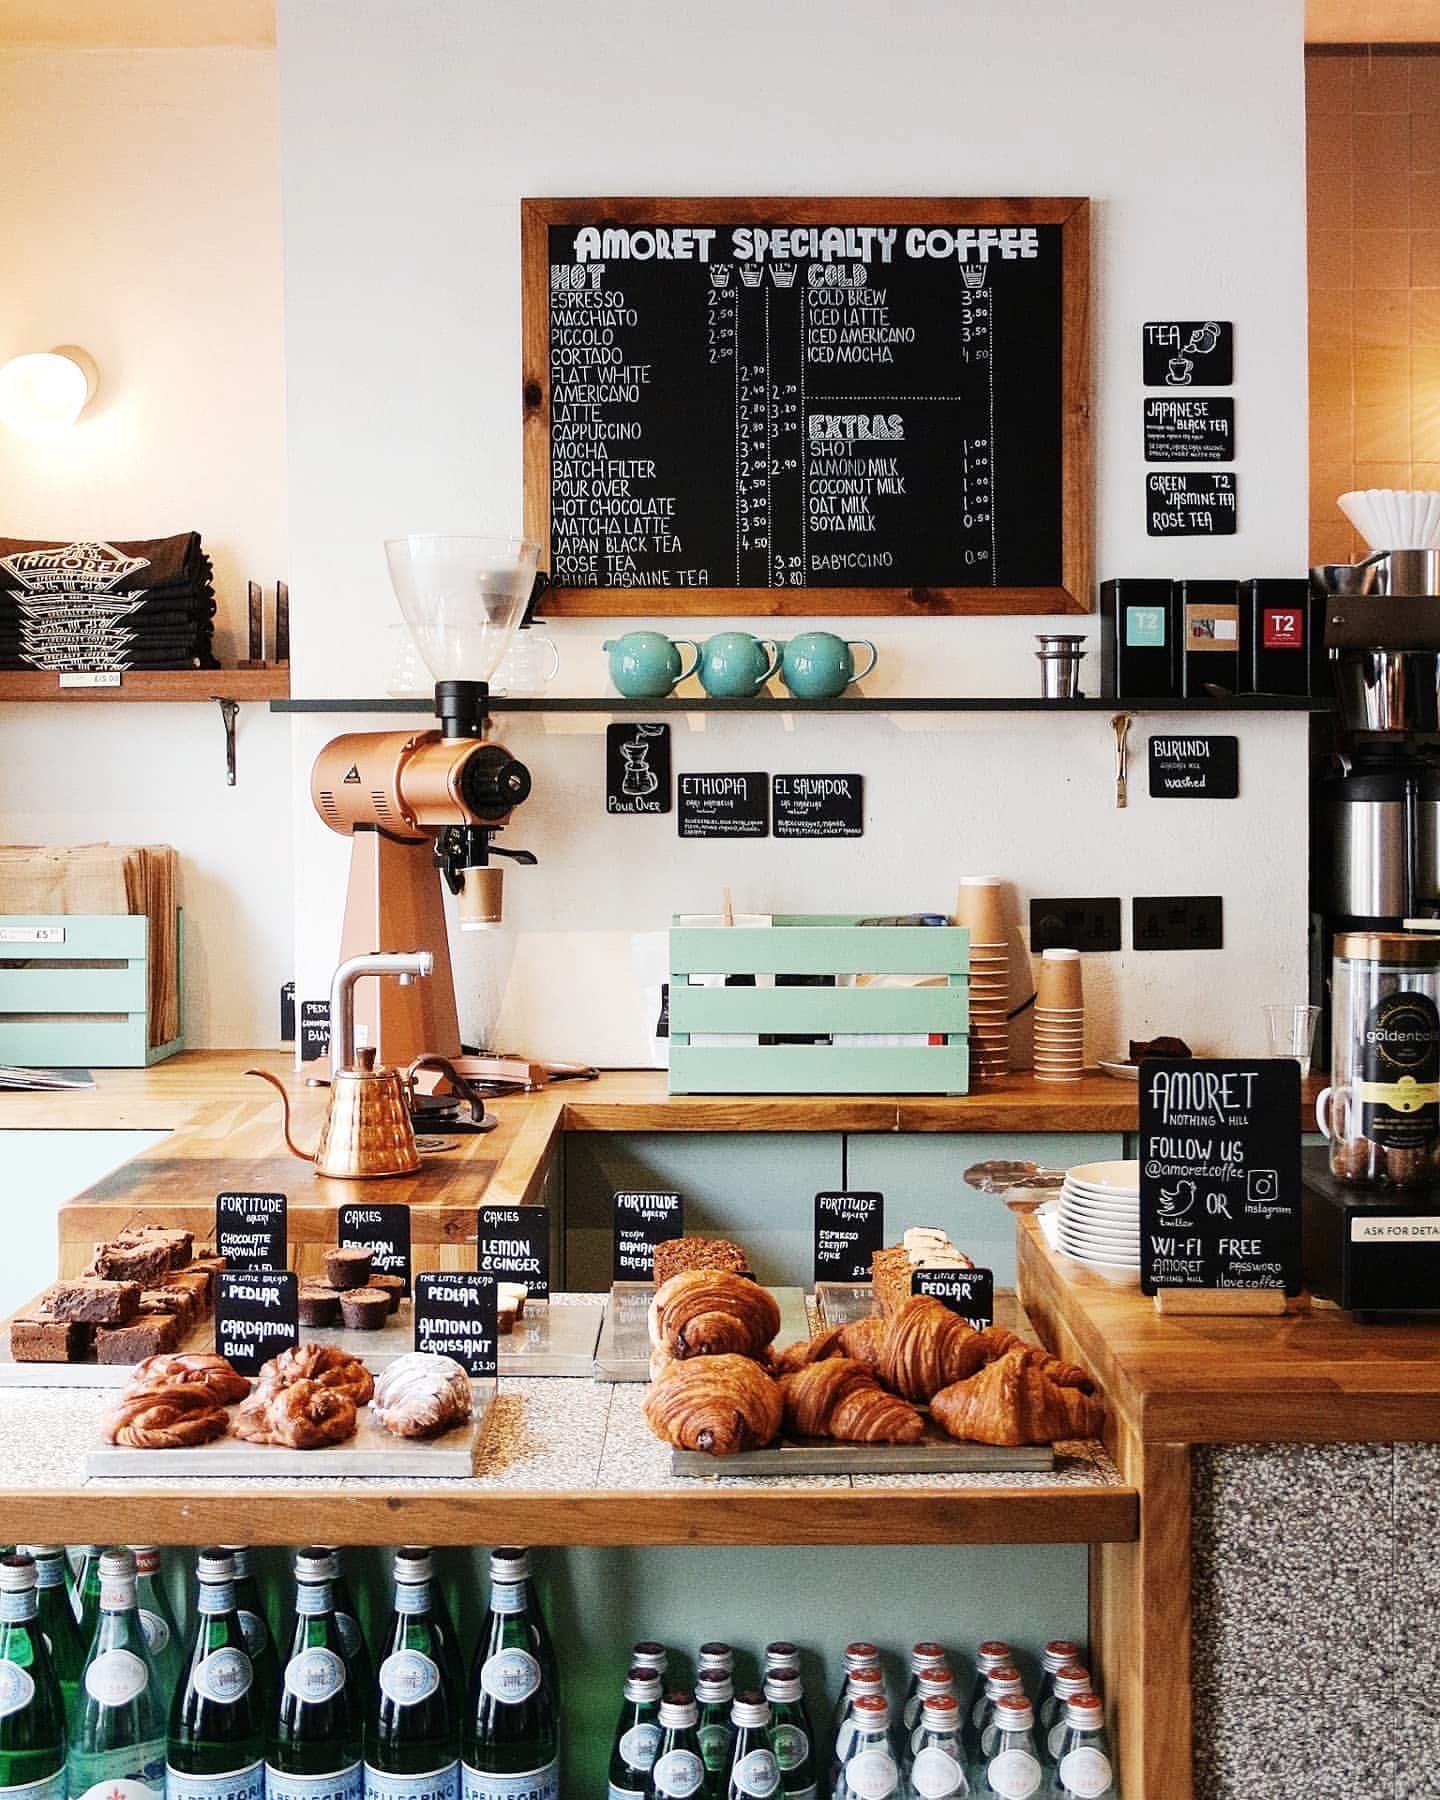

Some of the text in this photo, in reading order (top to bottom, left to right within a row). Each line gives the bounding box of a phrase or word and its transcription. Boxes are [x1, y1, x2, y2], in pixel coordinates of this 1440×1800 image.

[574, 227, 1039, 263] AMORET SPECIALTY COFFEE
[551, 264, 605, 290] HOT
[807, 264, 868, 288] COLD
[551, 289, 735, 309] ESPRESSO 2.00
[808, 289, 988, 306] COLD BREW 3.50
[551, 309, 638, 327] MACCHIATO
[809, 307, 988, 326] ICED LATTE 3.50
[551, 329, 614, 346] PICCOLO
[808, 327, 988, 345] ICED AMERICANO 3.50
[1144, 325, 1180, 350] TEA
[551, 347, 623, 365] CORTADO
[807, 346, 894, 363] ICED MOCHA
[551, 365, 652, 384] FLAT WHITE
[553, 384, 640, 403] AMERICANO
[553, 403, 603, 423] LATTE
[1146, 401, 1209, 425] JAPANESE
[552, 423, 642, 440] CAPPUCCINO
[808, 414, 905, 439] EXTRAS
[1176, 419, 1207, 433] BLACK
[1208, 419, 1228, 436] TEA
[552, 442, 609, 460] MOCHA
[810, 440, 856, 457] SHOT
[553, 461, 604, 479] BATCH
[608, 460, 656, 479] FILTER
[740, 461, 766, 477] 2.00
[809, 458, 866, 477] ALMOND
[868, 458, 899, 477] MILK
[552, 480, 590, 498] POUR
[592, 480, 631, 498] OVER
[809, 478, 875, 495] COCONUT
[877, 477, 907, 495] MILK
[1150, 476, 1187, 496] GREEN
[552, 498, 766, 516] HOT CHOCOLATE 3.20
[809, 496, 838, 514] OAT
[841, 496, 869, 514] MILK
[1166, 492, 1235, 511] JASMINE TEA
[552, 517, 766, 536] MATCHA LATTE 3.50
[810, 515, 846, 532] SOYA
[848, 515, 876, 532] MILK
[1152, 511, 1213, 532] ROSE TEA
[552, 537, 599, 555] JAPAN
[606, 536, 648, 554] BLACK
[652, 536, 682, 553] TEA
[556, 555, 601, 573] ROSE
[605, 555, 637, 572] TEA
[811, 551, 893, 571] BABYCCINO
[553, 572, 598, 587] CHINA
[604, 570, 671, 588] JASMINE
[675, 569, 708, 586] TEA
[1271, 615, 1295, 632] T2
[1153, 740, 1209, 761] BURUNDI
[681, 777, 747, 801] ETHIOPIA
[774, 778, 851, 801] EL SALVADOR
[1164, 774, 1206, 789] washed
[306, 1004, 329, 1015] PEDL
[1148, 1071, 1260, 1124] AMORET
[1169, 1114, 1249, 1127] NOTHING HILL
[1150, 1136, 1244, 1162] FOLLOW US
[1145, 1160, 1245, 1182] @amoretcoffee
[220, 1197, 283, 1216] FORTITUDE
[618, 1194, 679, 1213] FORTITUDE
[820, 1197, 877, 1215] FORTITUDE
[1206, 1193, 1232, 1219] OR
[344, 1210, 382, 1230] CAKIES
[484, 1210, 520, 1229] CAKIES
[221, 1232, 272, 1248] CHOCOLATE
[620, 1231, 644, 1240] VEGAN
[819, 1230, 859, 1240] ESPRESSO
[1364, 1226, 1440, 1236] ASK FOR DETA
[221, 1246, 269, 1261] BROWNIE
[482, 1239, 530, 1257] LEMON
[619, 1241, 657, 1256] BANAN
[818, 1240, 849, 1252] CREAM
[1151, 1235, 1263, 1259] WI-FI FREE
[370, 1254, 406, 1271] OLATE
[818, 1251, 840, 1262] CAKE
[917, 1272, 932, 1280] THE
[1152, 1258, 1205, 1276] AMORET
[1229, 1261, 1282, 1276] PASSWORD
[222, 1274, 237, 1282] THE
[239, 1274, 258, 1282] LITTLE
[438, 1275, 463, 1283] LITTLE
[228, 1285, 280, 1307] PEDLAR
[428, 1286, 480, 1307] PEDLAR
[921, 1281, 972, 1301] PEDLAR
[220, 1319, 295, 1342] CARDAMON
[418, 1318, 483, 1340] ALMOND
[223, 1342, 255, 1358] BUN
[420, 1339, 492, 1358] CROISSANT
[471, 1361, 496, 1371] £3.20
